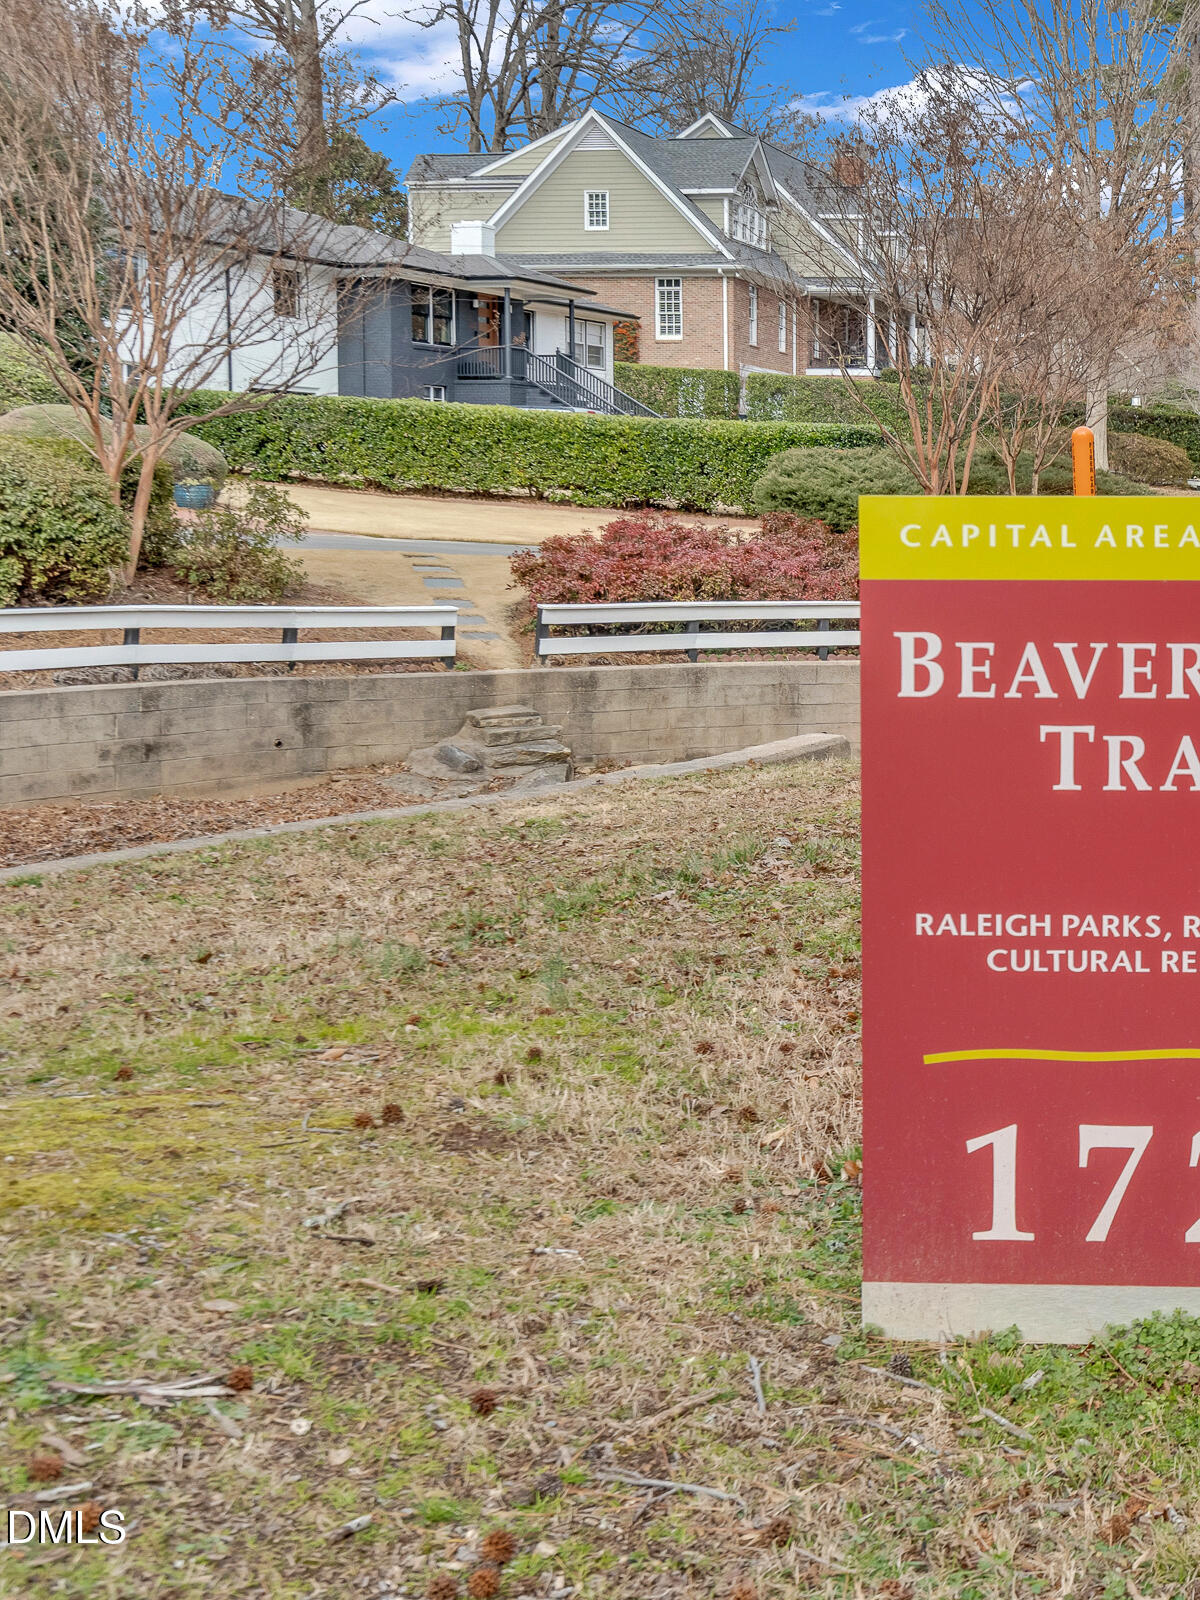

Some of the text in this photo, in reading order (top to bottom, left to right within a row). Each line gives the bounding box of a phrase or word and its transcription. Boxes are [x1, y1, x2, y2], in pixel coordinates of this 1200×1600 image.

[899, 523, 1077, 549] CAPITAL
[1094, 524, 1200, 549] AREA
[914, 912, 1052, 937] RALEIGH
[1062, 914, 1173, 943] PARKS,
[985, 948, 1151, 973] CULTURAL
